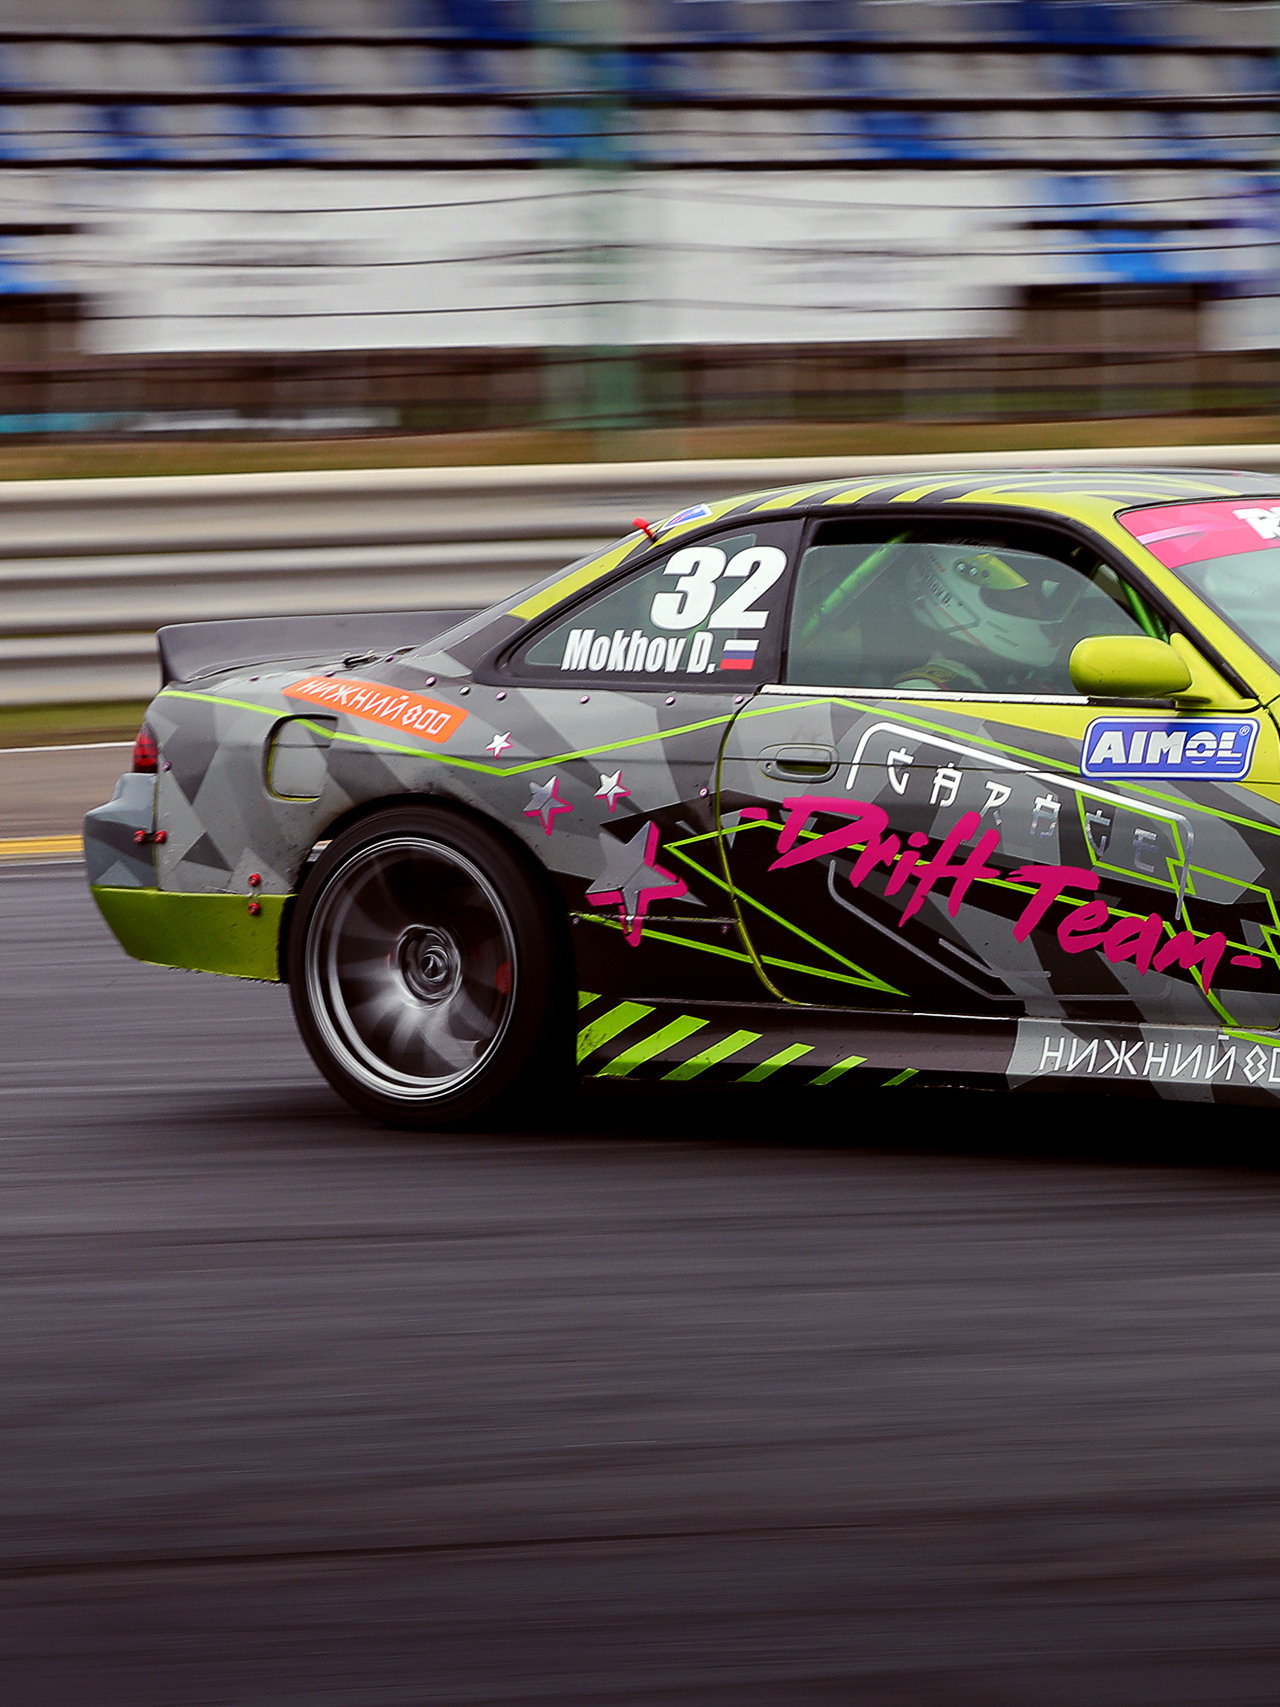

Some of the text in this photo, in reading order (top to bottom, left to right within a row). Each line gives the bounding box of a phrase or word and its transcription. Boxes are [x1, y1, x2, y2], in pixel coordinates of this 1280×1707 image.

[650, 546, 787, 630] 32
[560, 628, 716, 674] Mokhov D.
[296, 680, 403, 721] НИЖНИЙ
[1038, 1034, 1237, 1081] НИЖНИЙ
